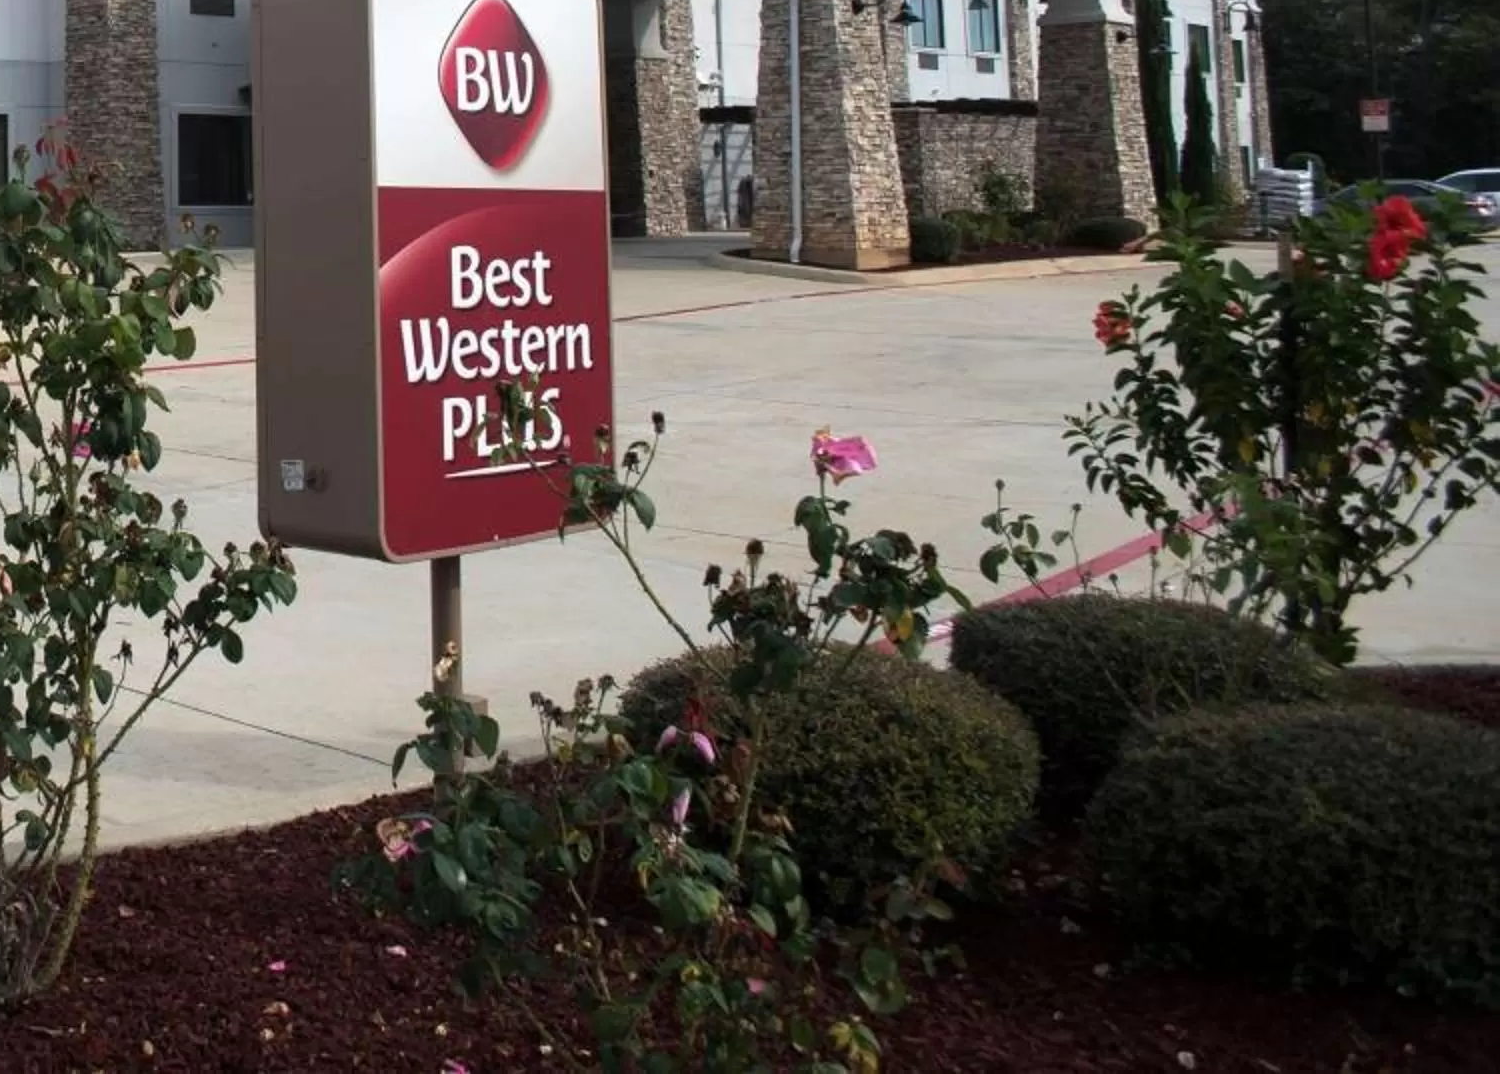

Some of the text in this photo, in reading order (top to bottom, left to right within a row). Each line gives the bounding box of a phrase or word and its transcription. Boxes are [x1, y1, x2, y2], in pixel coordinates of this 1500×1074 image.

[454, 45, 534, 115] BW
[450, 244, 553, 308] Best
[400, 317, 593, 383] Western
